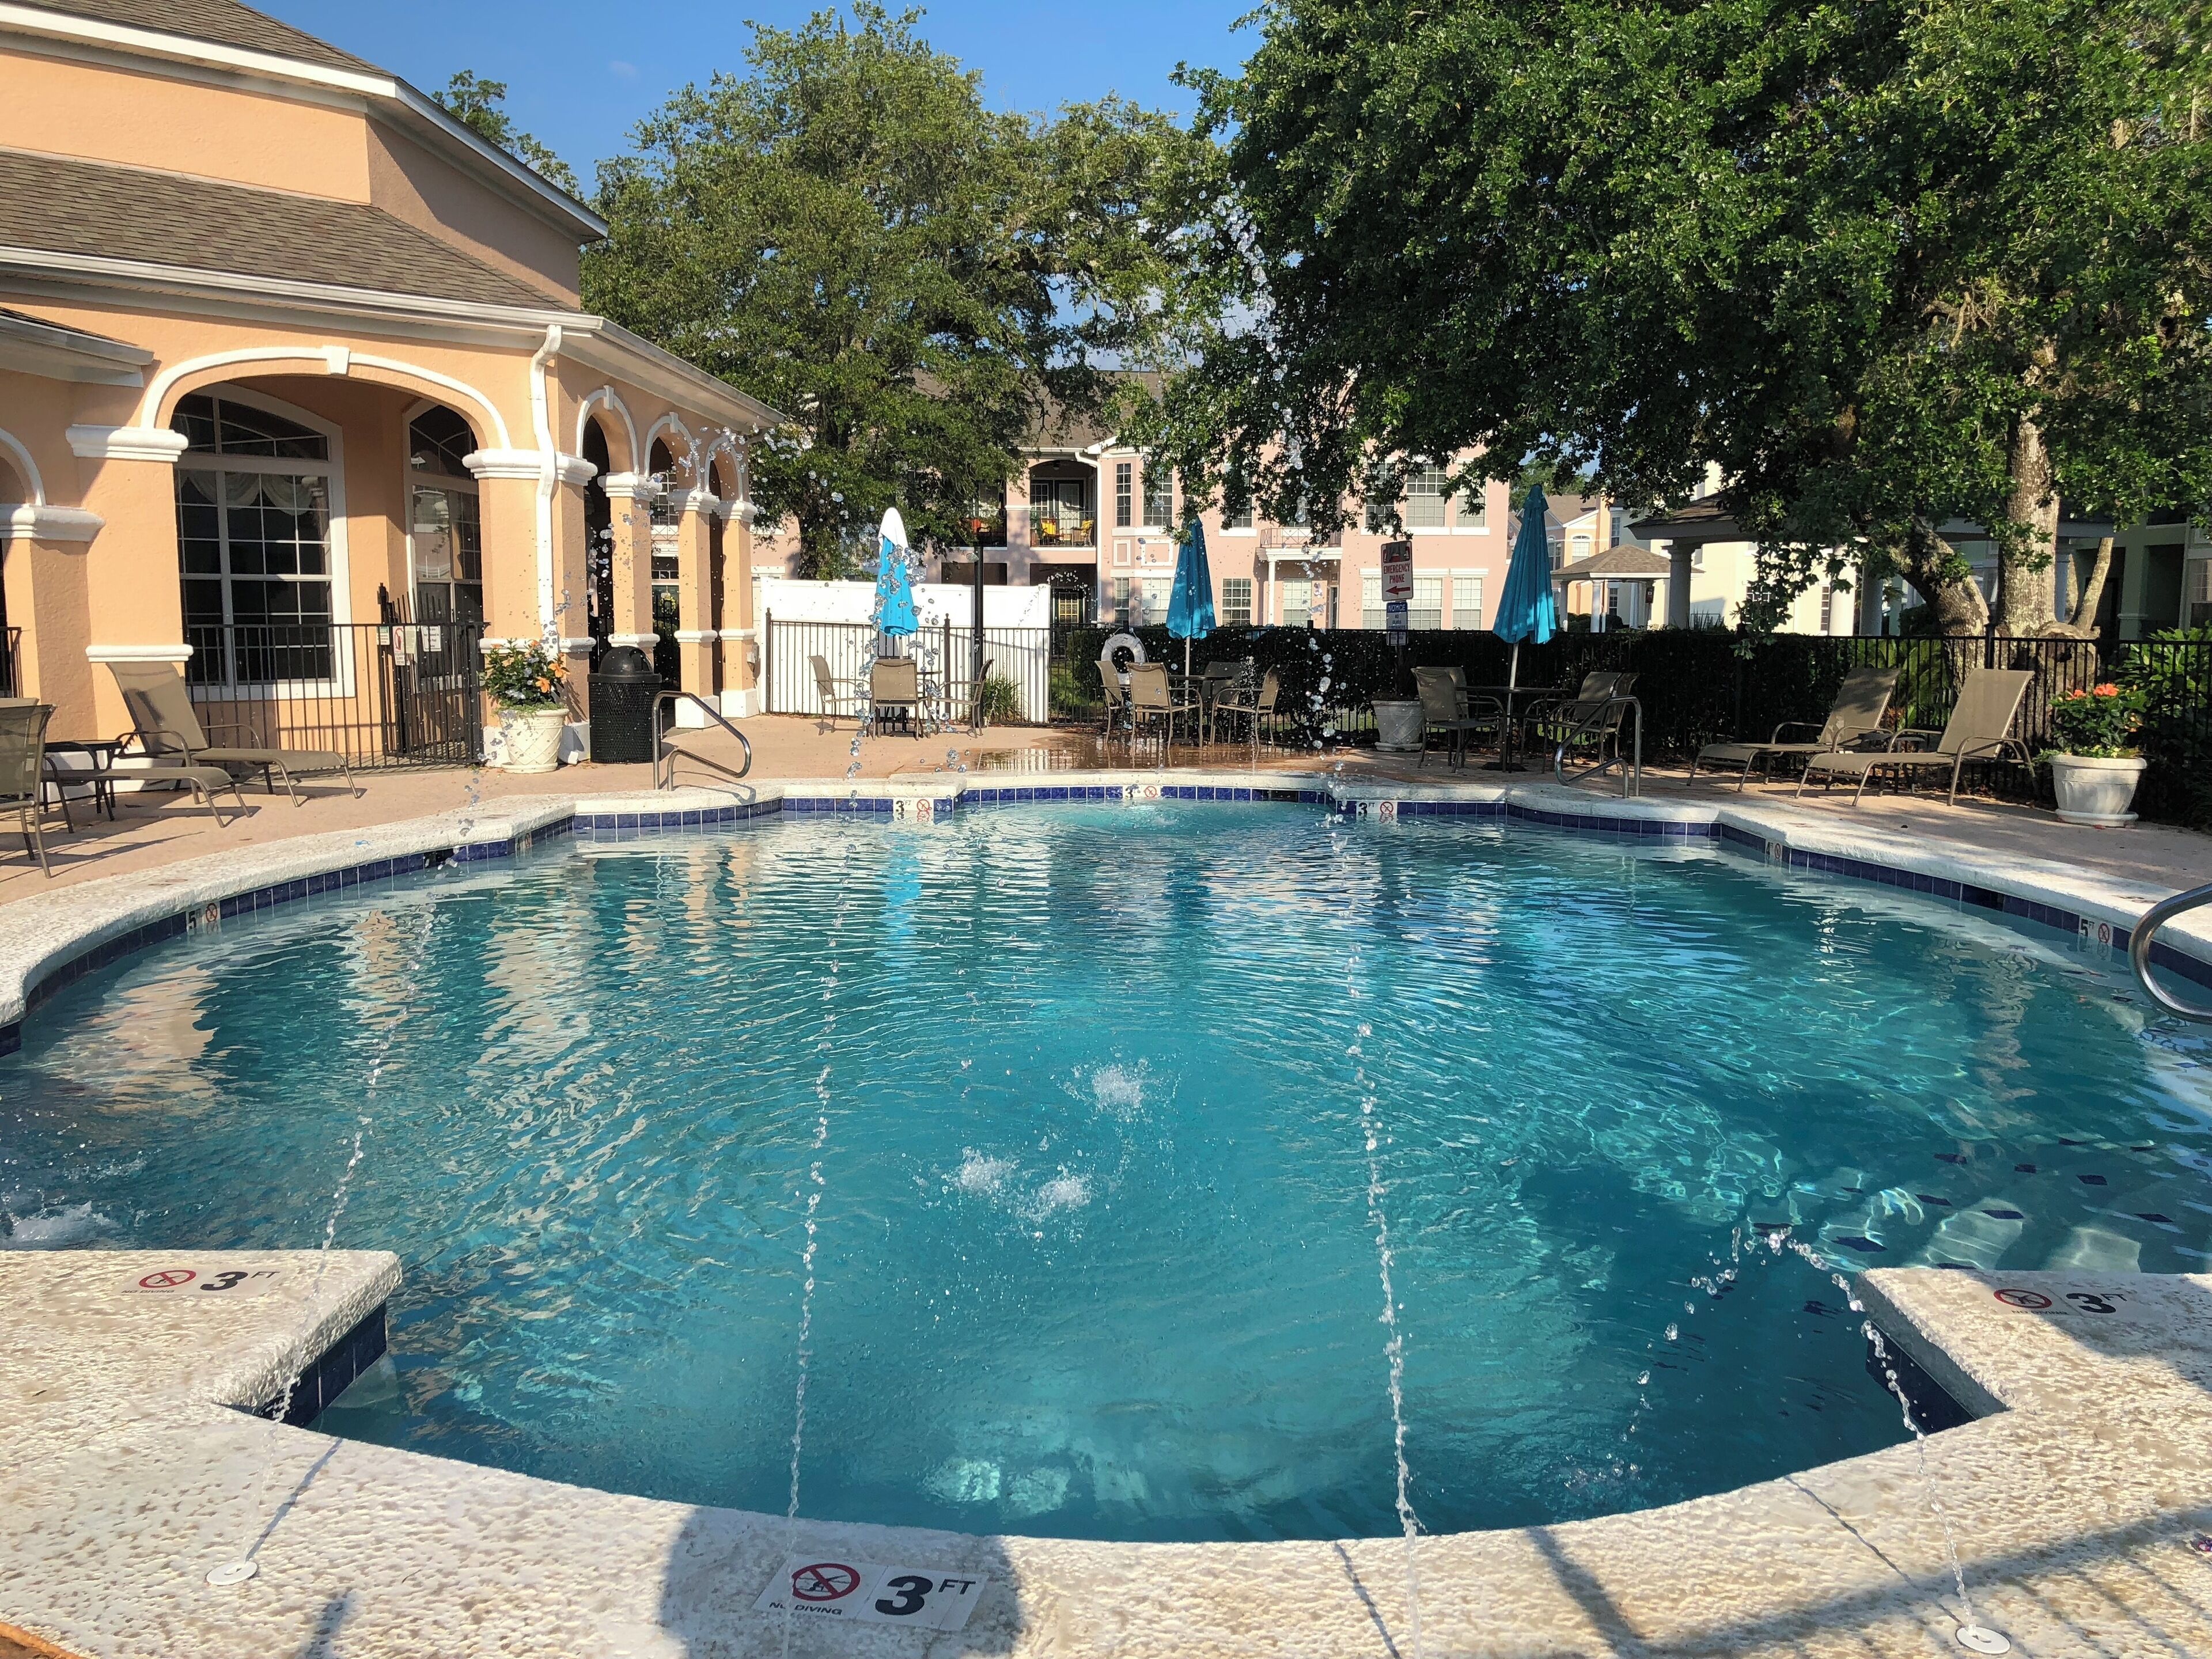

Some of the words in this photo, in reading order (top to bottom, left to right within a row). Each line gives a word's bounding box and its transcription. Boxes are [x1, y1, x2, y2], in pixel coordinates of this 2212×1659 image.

[1383, 563, 1410, 574] EMERGENCY
[1389, 574, 1405, 584] PHONE
[1388, 604, 1406, 612] NOTICE
[896, 800, 904, 813] 3
[1358, 802, 1368, 816] 3
[1766, 842, 1770, 855] 4
[188, 910, 196, 929] 5
[2079, 918, 2088, 937] 5
[200, 1271, 248, 1291] 3
[251, 1271, 281, 1279] FT
[2066, 1293, 2117, 1314] 3
[2100, 1293, 2128, 1302] FT
[874, 1575, 933, 1615] 3
[938, 1579, 976, 1595] FT
[794, 1604, 843, 1615] DIVING
